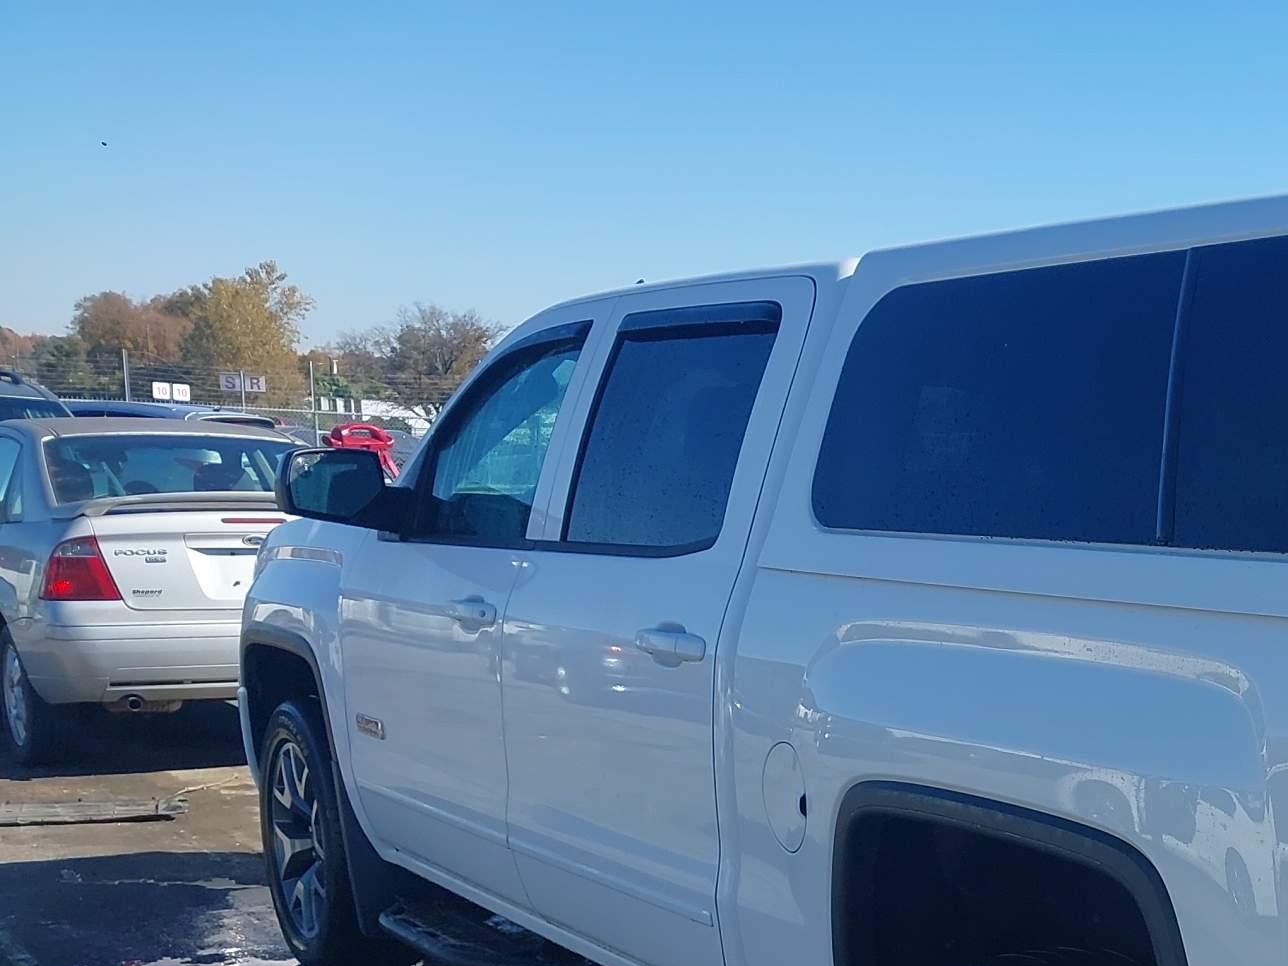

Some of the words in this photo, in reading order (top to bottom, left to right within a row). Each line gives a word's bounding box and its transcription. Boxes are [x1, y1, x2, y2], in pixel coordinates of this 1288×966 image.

[224, 376, 236, 390] S
[249, 377, 262, 390] R
[156, 386, 168, 396] 10
[176, 388, 188, 398] 10
[113, 548, 168, 556] FOCUS
